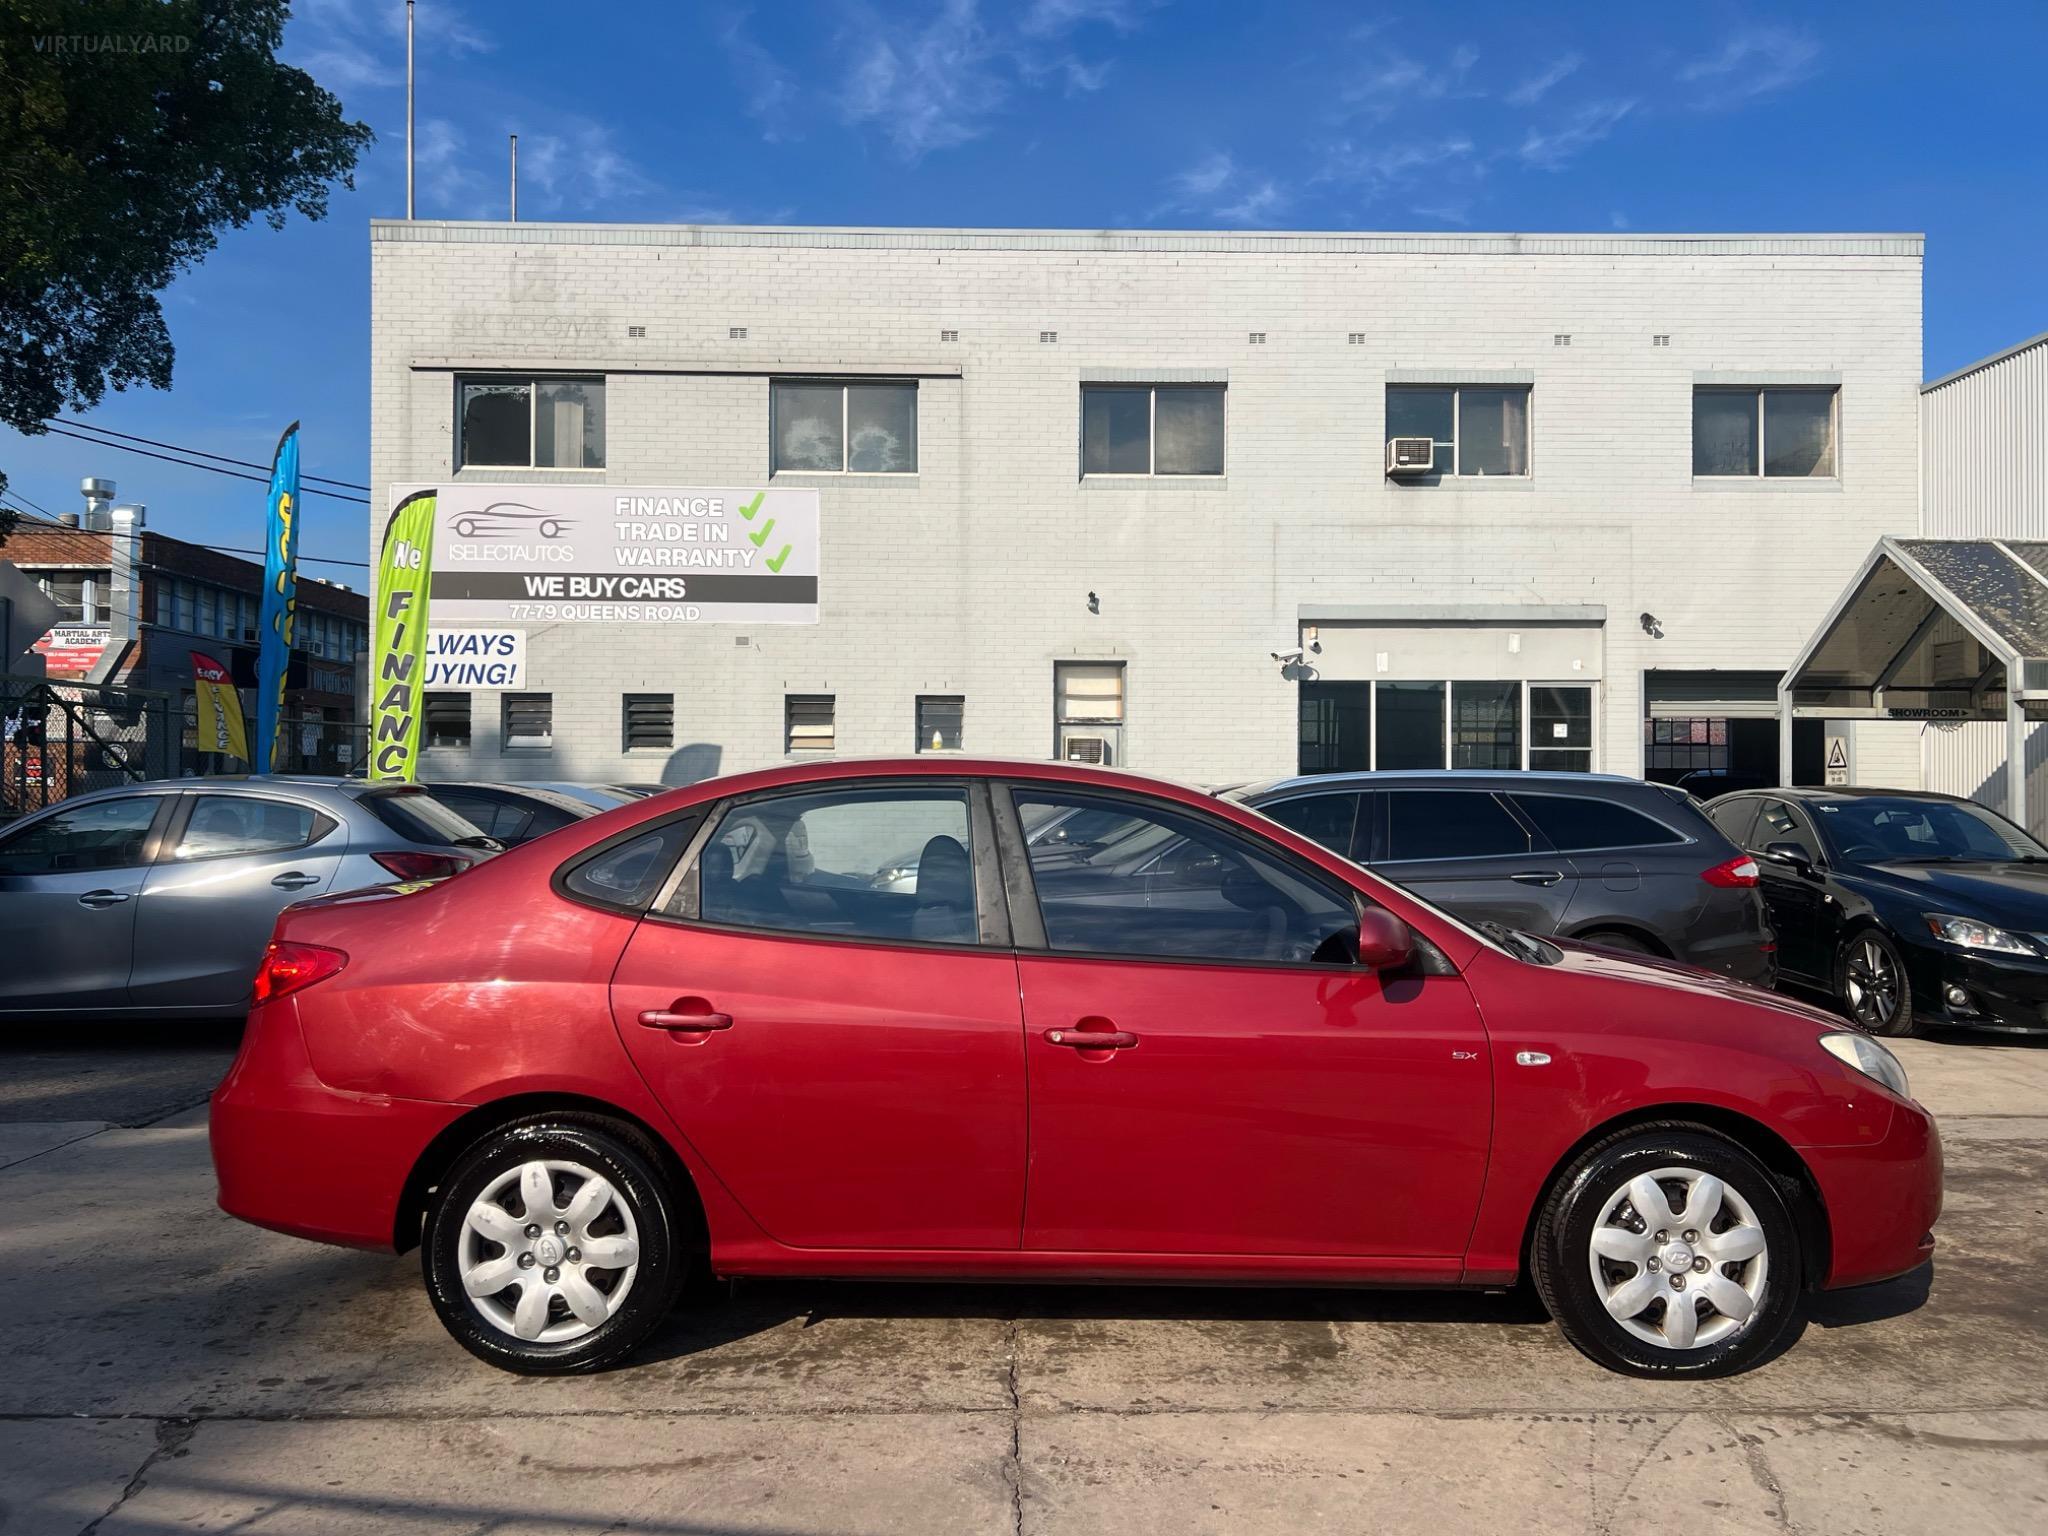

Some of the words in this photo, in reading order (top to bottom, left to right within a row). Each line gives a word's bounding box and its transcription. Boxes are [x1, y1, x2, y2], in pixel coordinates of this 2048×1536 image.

[614, 496, 724, 517] FINANCE
[614, 521, 698, 541] TRADE
[703, 522, 729, 542] IN
[449, 543, 574, 562] ISELECTAUTOS
[614, 546, 757, 568] WARRANTY
[524, 576, 565, 597] WE
[569, 576, 619, 598] BUY
[619, 577, 687, 599] CARS
[509, 604, 558, 620] 77-79
[561, 604, 640, 621] QUEENS
[644, 605, 702, 622] ROAD
[54, 630, 90, 638] MARTIAL
[64, 637, 102, 645] ACADEMY
[426, 634, 516, 656] LWAYS
[425, 663, 517, 685] UYING!
[377, 590, 414, 781] FINANC
[1887, 708, 1960, 718] SHOWROOM
[1452, 1051, 1478, 1060] SX
